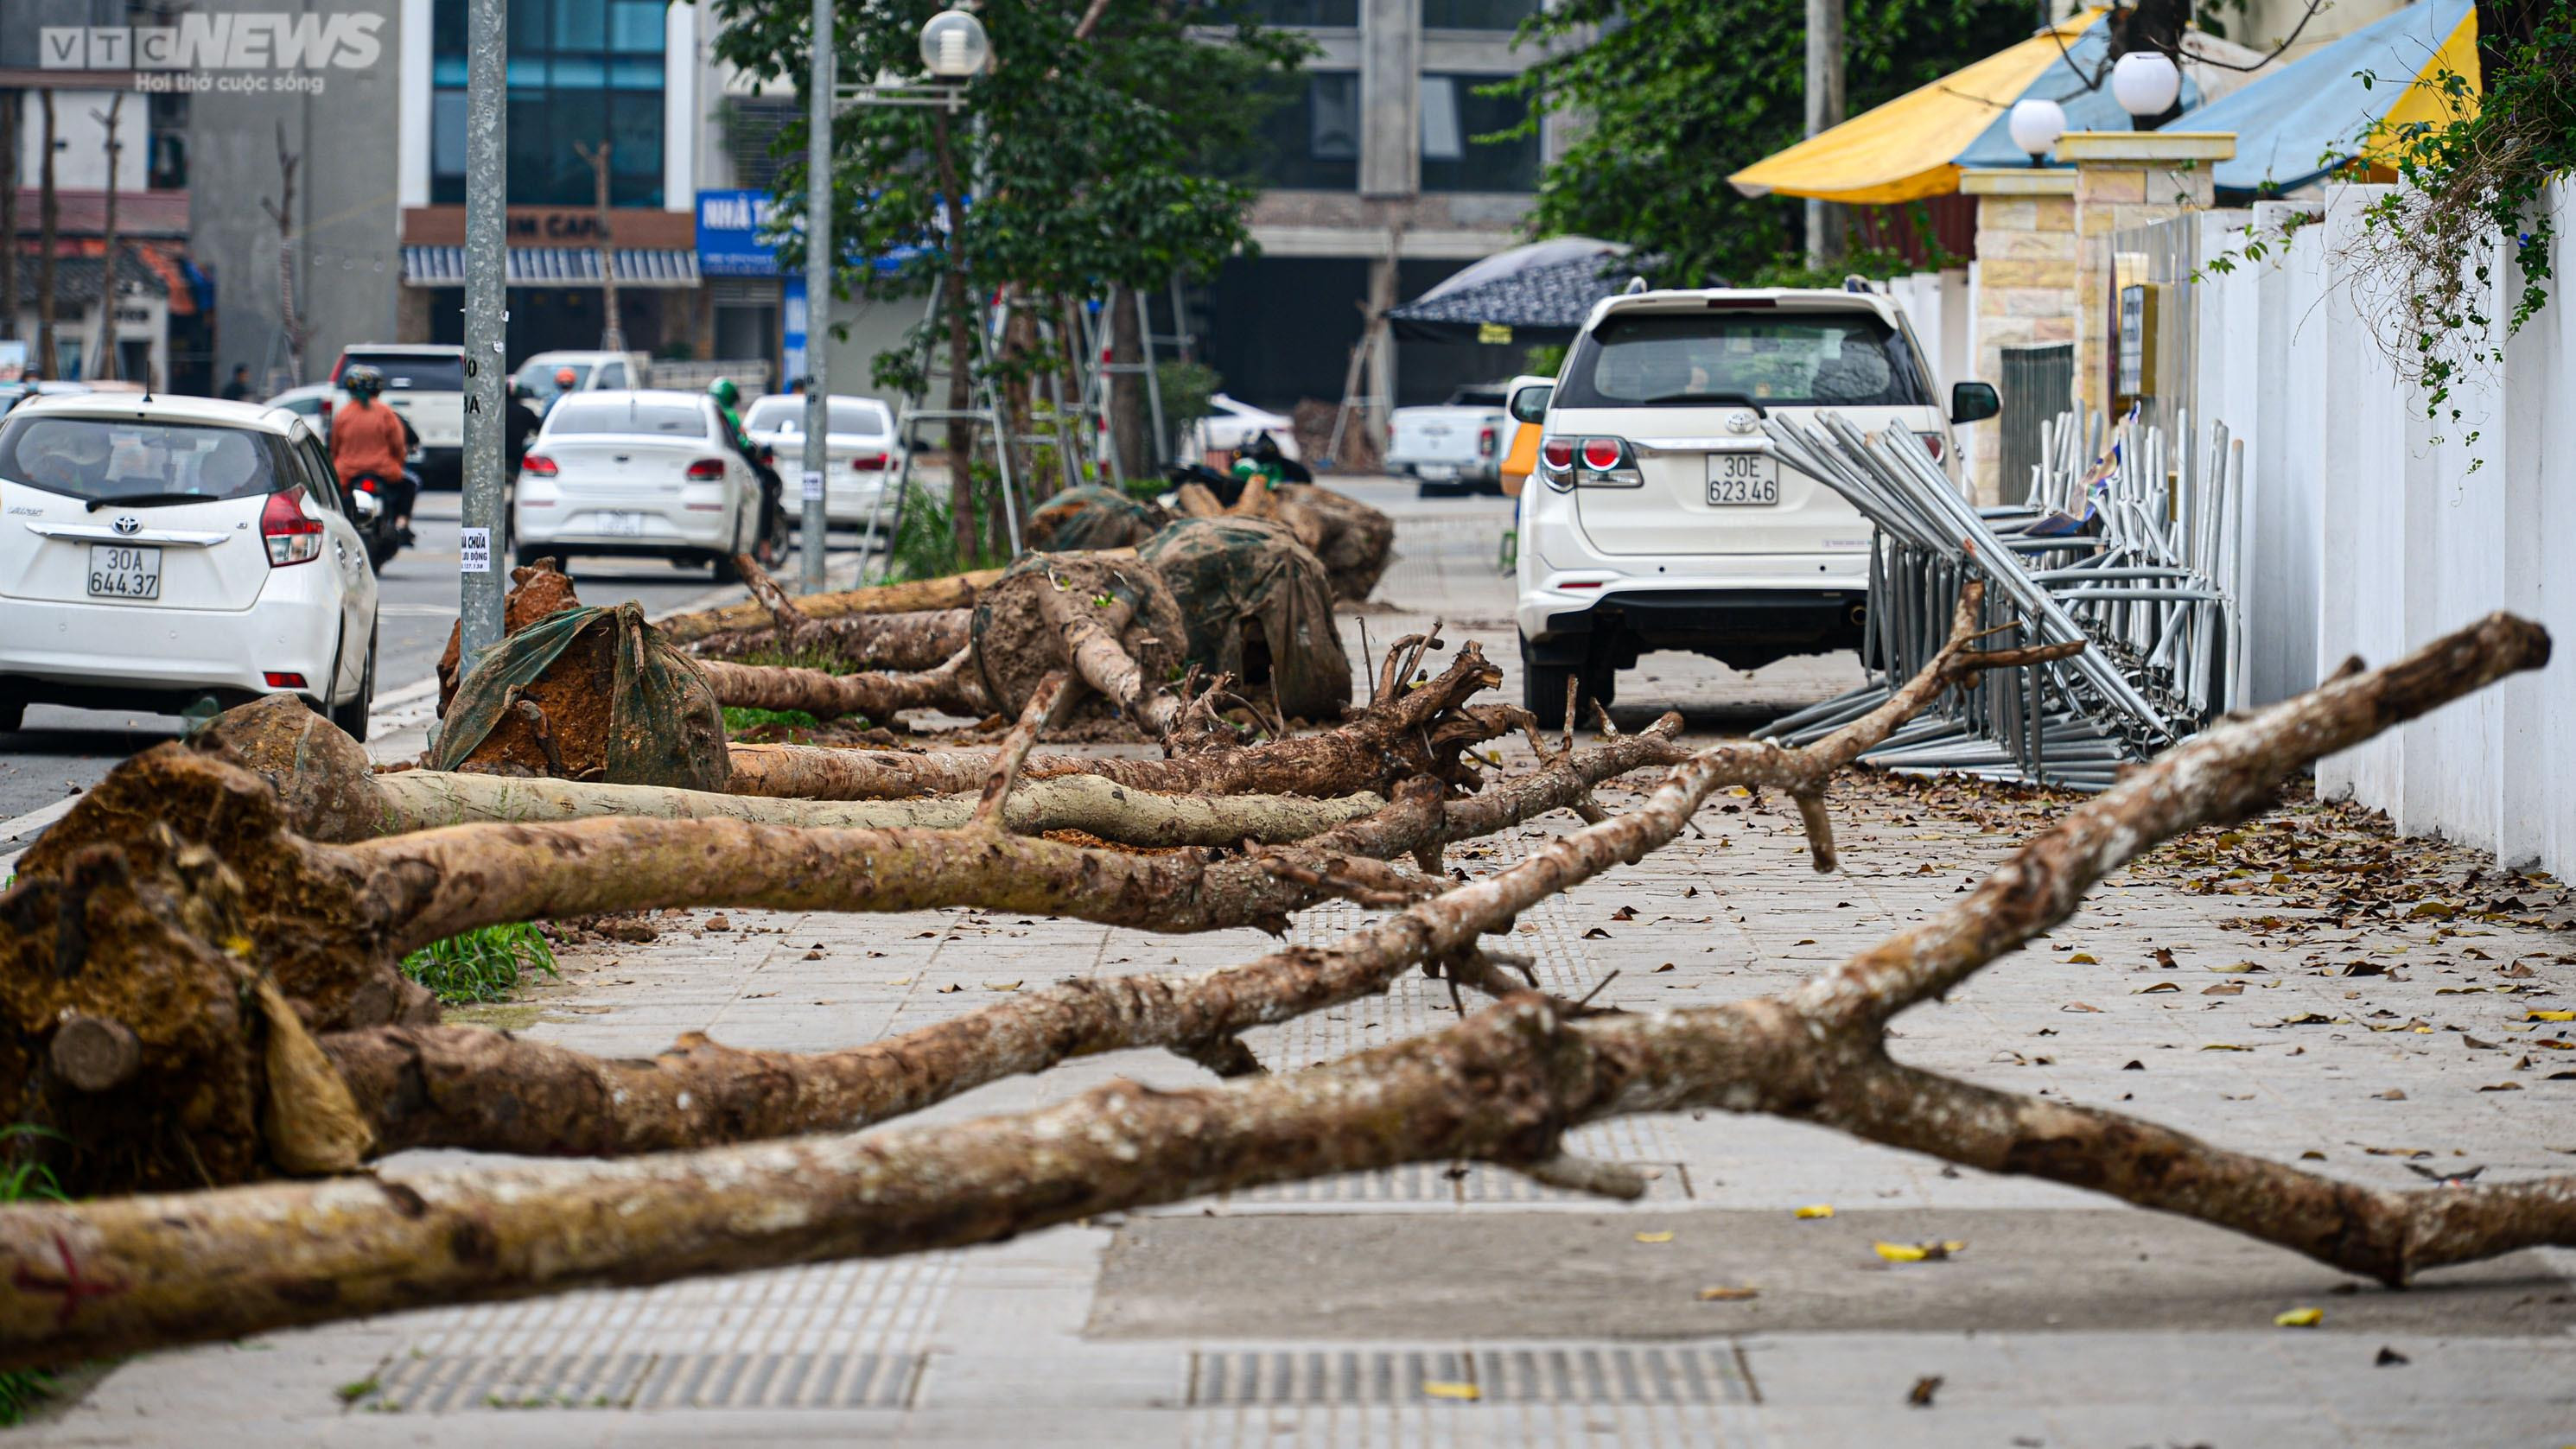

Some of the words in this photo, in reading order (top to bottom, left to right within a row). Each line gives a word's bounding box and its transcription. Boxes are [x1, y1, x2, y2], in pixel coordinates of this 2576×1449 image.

[1724, 456, 1760, 478] 30E
[1710, 480, 1775, 501] 623.46
[467, 532, 486, 550] CHỮA
[107, 549, 143, 571] 30A
[91, 572, 157, 595] 644.37
